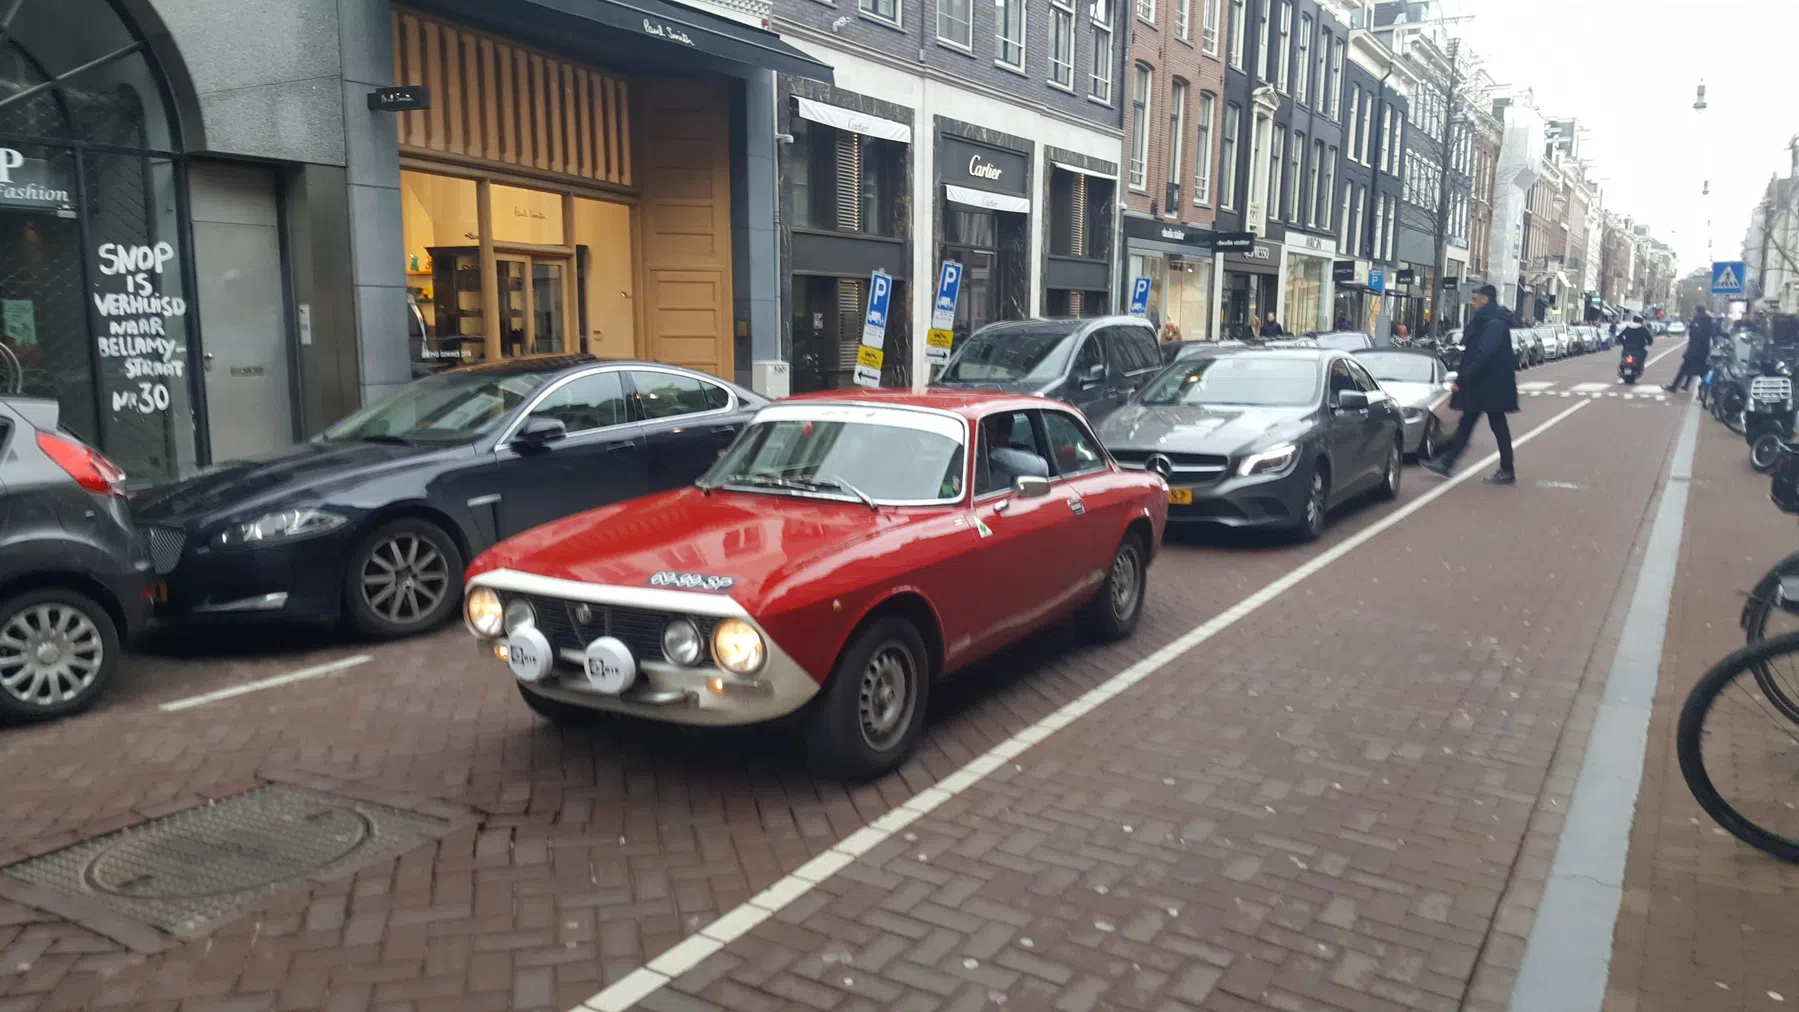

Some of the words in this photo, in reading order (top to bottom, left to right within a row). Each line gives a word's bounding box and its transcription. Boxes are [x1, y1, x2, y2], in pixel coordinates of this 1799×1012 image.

[643, 18, 666, 36] Paul
[666, 26, 696, 46] Smith
[847, 117, 870, 133] Cartier
[968, 154, 1002, 180] Cartier
[98, 241, 174, 275] SNOP
[126, 273, 153, 297] IS
[873, 278, 887, 305] P
[943, 266, 957, 292] P
[1135, 280, 1147, 299] P
[109, 317, 166, 336] NAAR
[124, 358, 185, 379] STRAAT
[138, 381, 170, 414] 30
